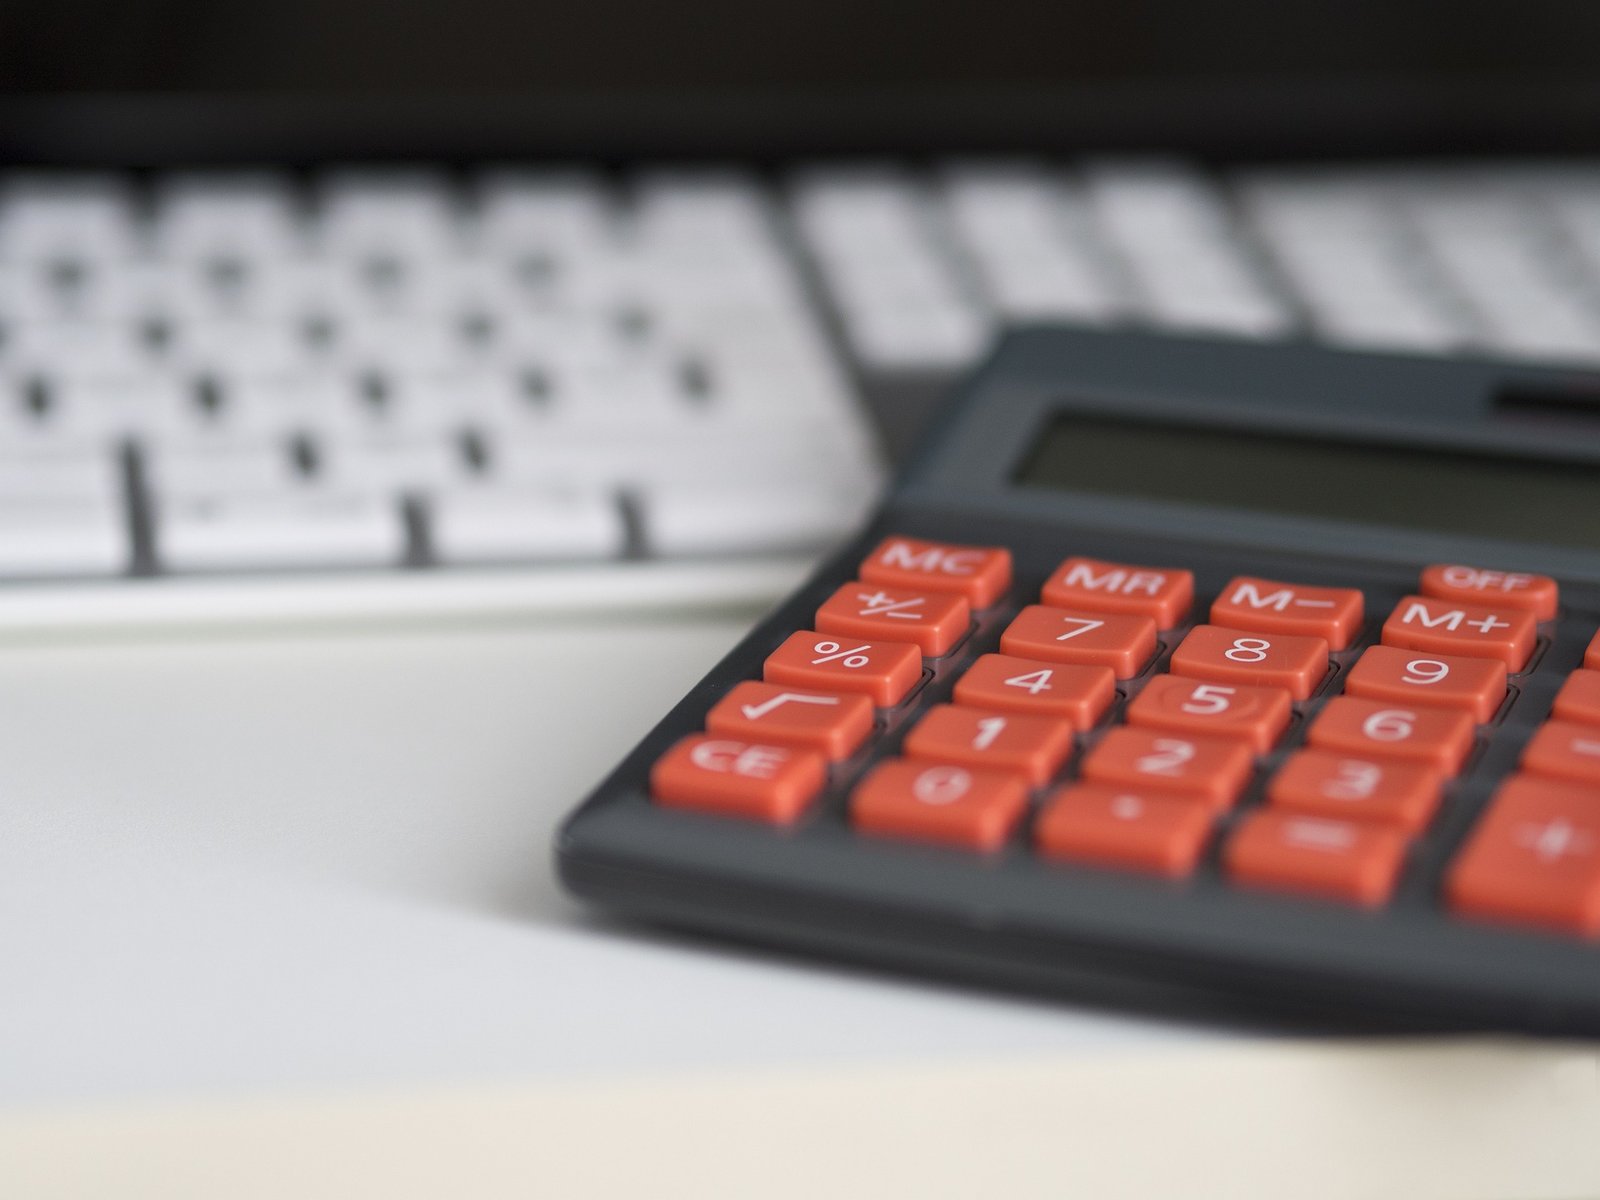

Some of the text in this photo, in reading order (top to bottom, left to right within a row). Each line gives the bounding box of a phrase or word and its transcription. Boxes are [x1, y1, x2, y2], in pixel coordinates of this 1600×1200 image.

[881, 542, 984, 573] MC
[1065, 562, 1165, 596] MR
[1442, 565, 1536, 592] OFF
[1055, 616, 1105, 641] 7
[1402, 603, 1510, 633] M+
[811, 640, 872, 669] %
[1224, 637, 1271, 663] 8
[1004, 668, 1054, 695] 4
[1402, 659, 1450, 685] 9
[1183, 684, 1235, 714] 5
[973, 716, 1007, 749] 1
[1363, 709, 1415, 740] 6
[689, 740, 788, 779] CE
[1137, 739, 1196, 775] 2
[913, 767, 972, 804] 0
[1327, 760, 1382, 798] 3
